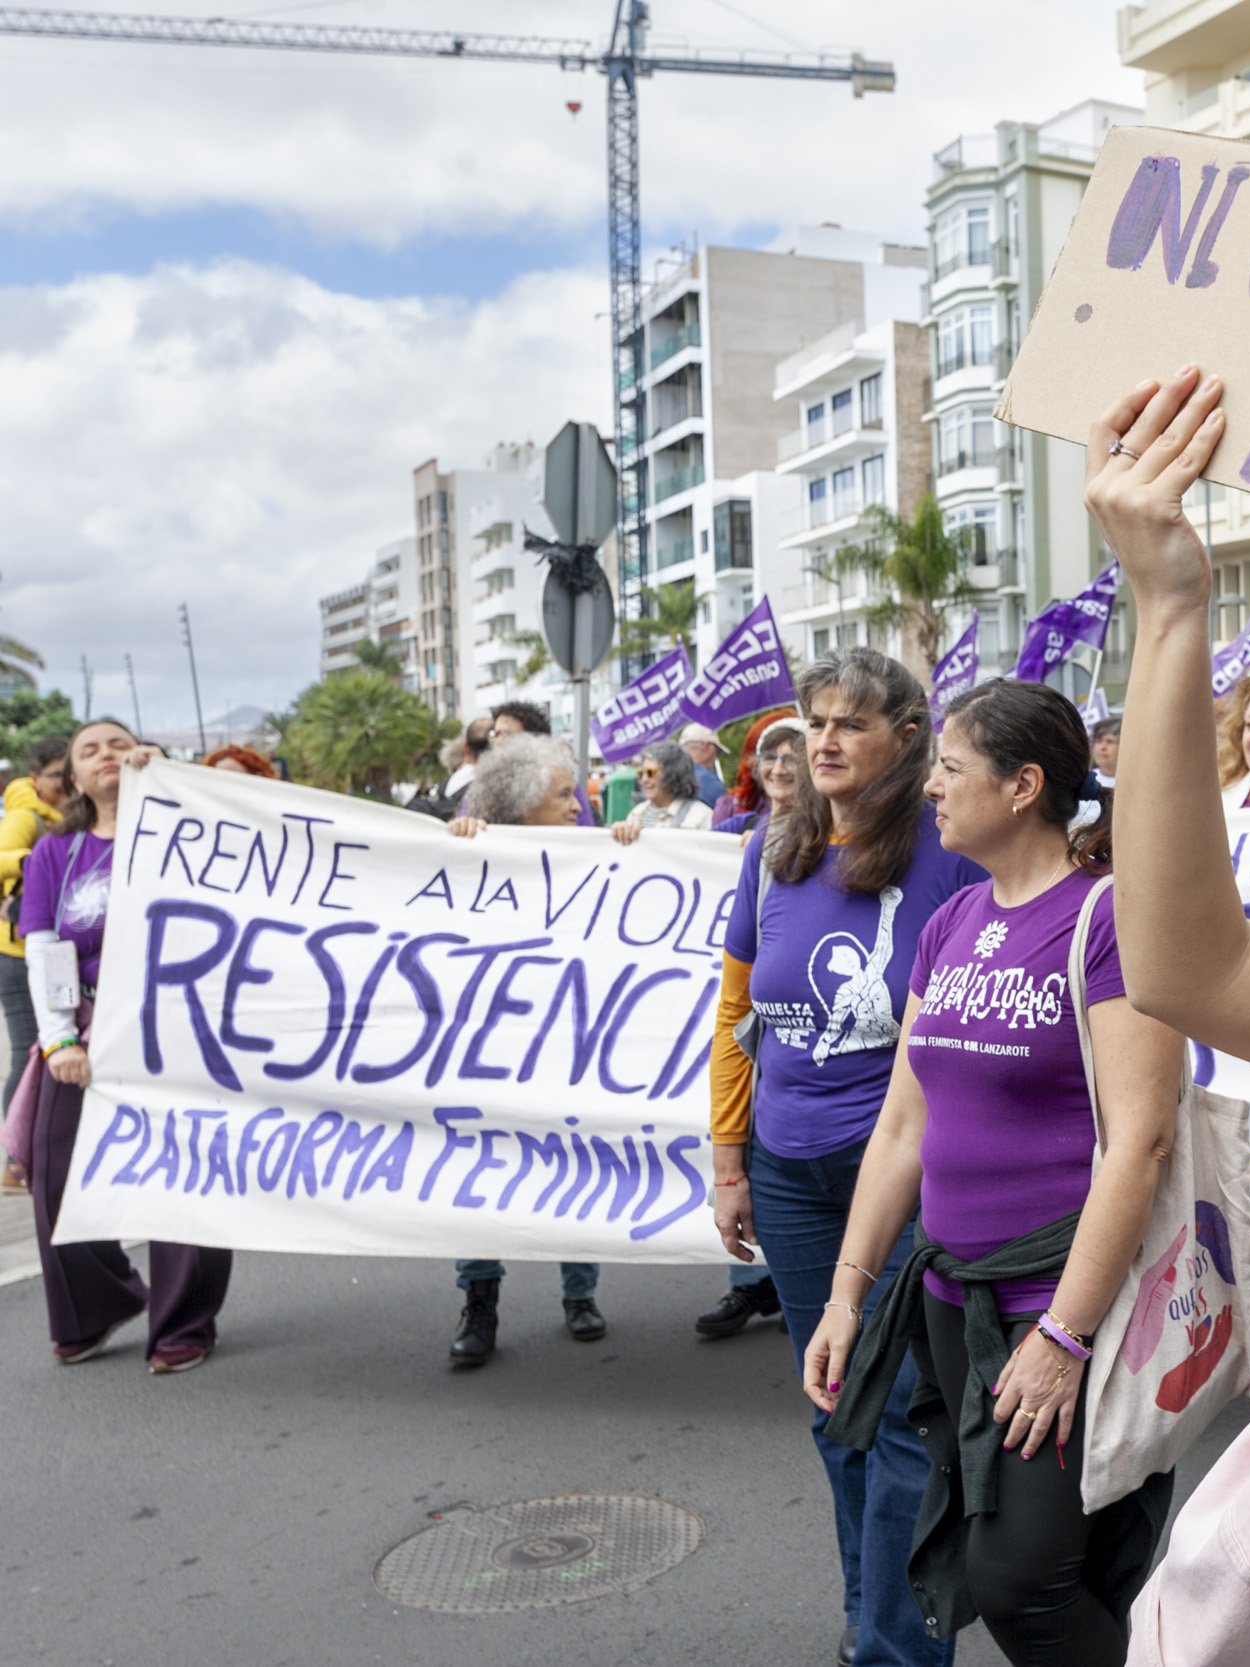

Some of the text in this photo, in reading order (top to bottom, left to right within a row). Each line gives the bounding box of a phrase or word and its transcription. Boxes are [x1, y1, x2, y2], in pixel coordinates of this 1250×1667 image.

[128, 797, 369, 908] FRENTE
[406, 868, 453, 909] A
[469, 859, 518, 913] LA
[142, 899, 722, 1099] RESISTENCI
[751, 1000, 814, 1017] EVUELTA
[990, 988, 1057, 1012] LUCHA
[928, 1036, 963, 1050] FEMINISTA
[979, 1042, 1030, 1057] LANZAROTE
[81, 1104, 414, 1200] PLATAFORMA
